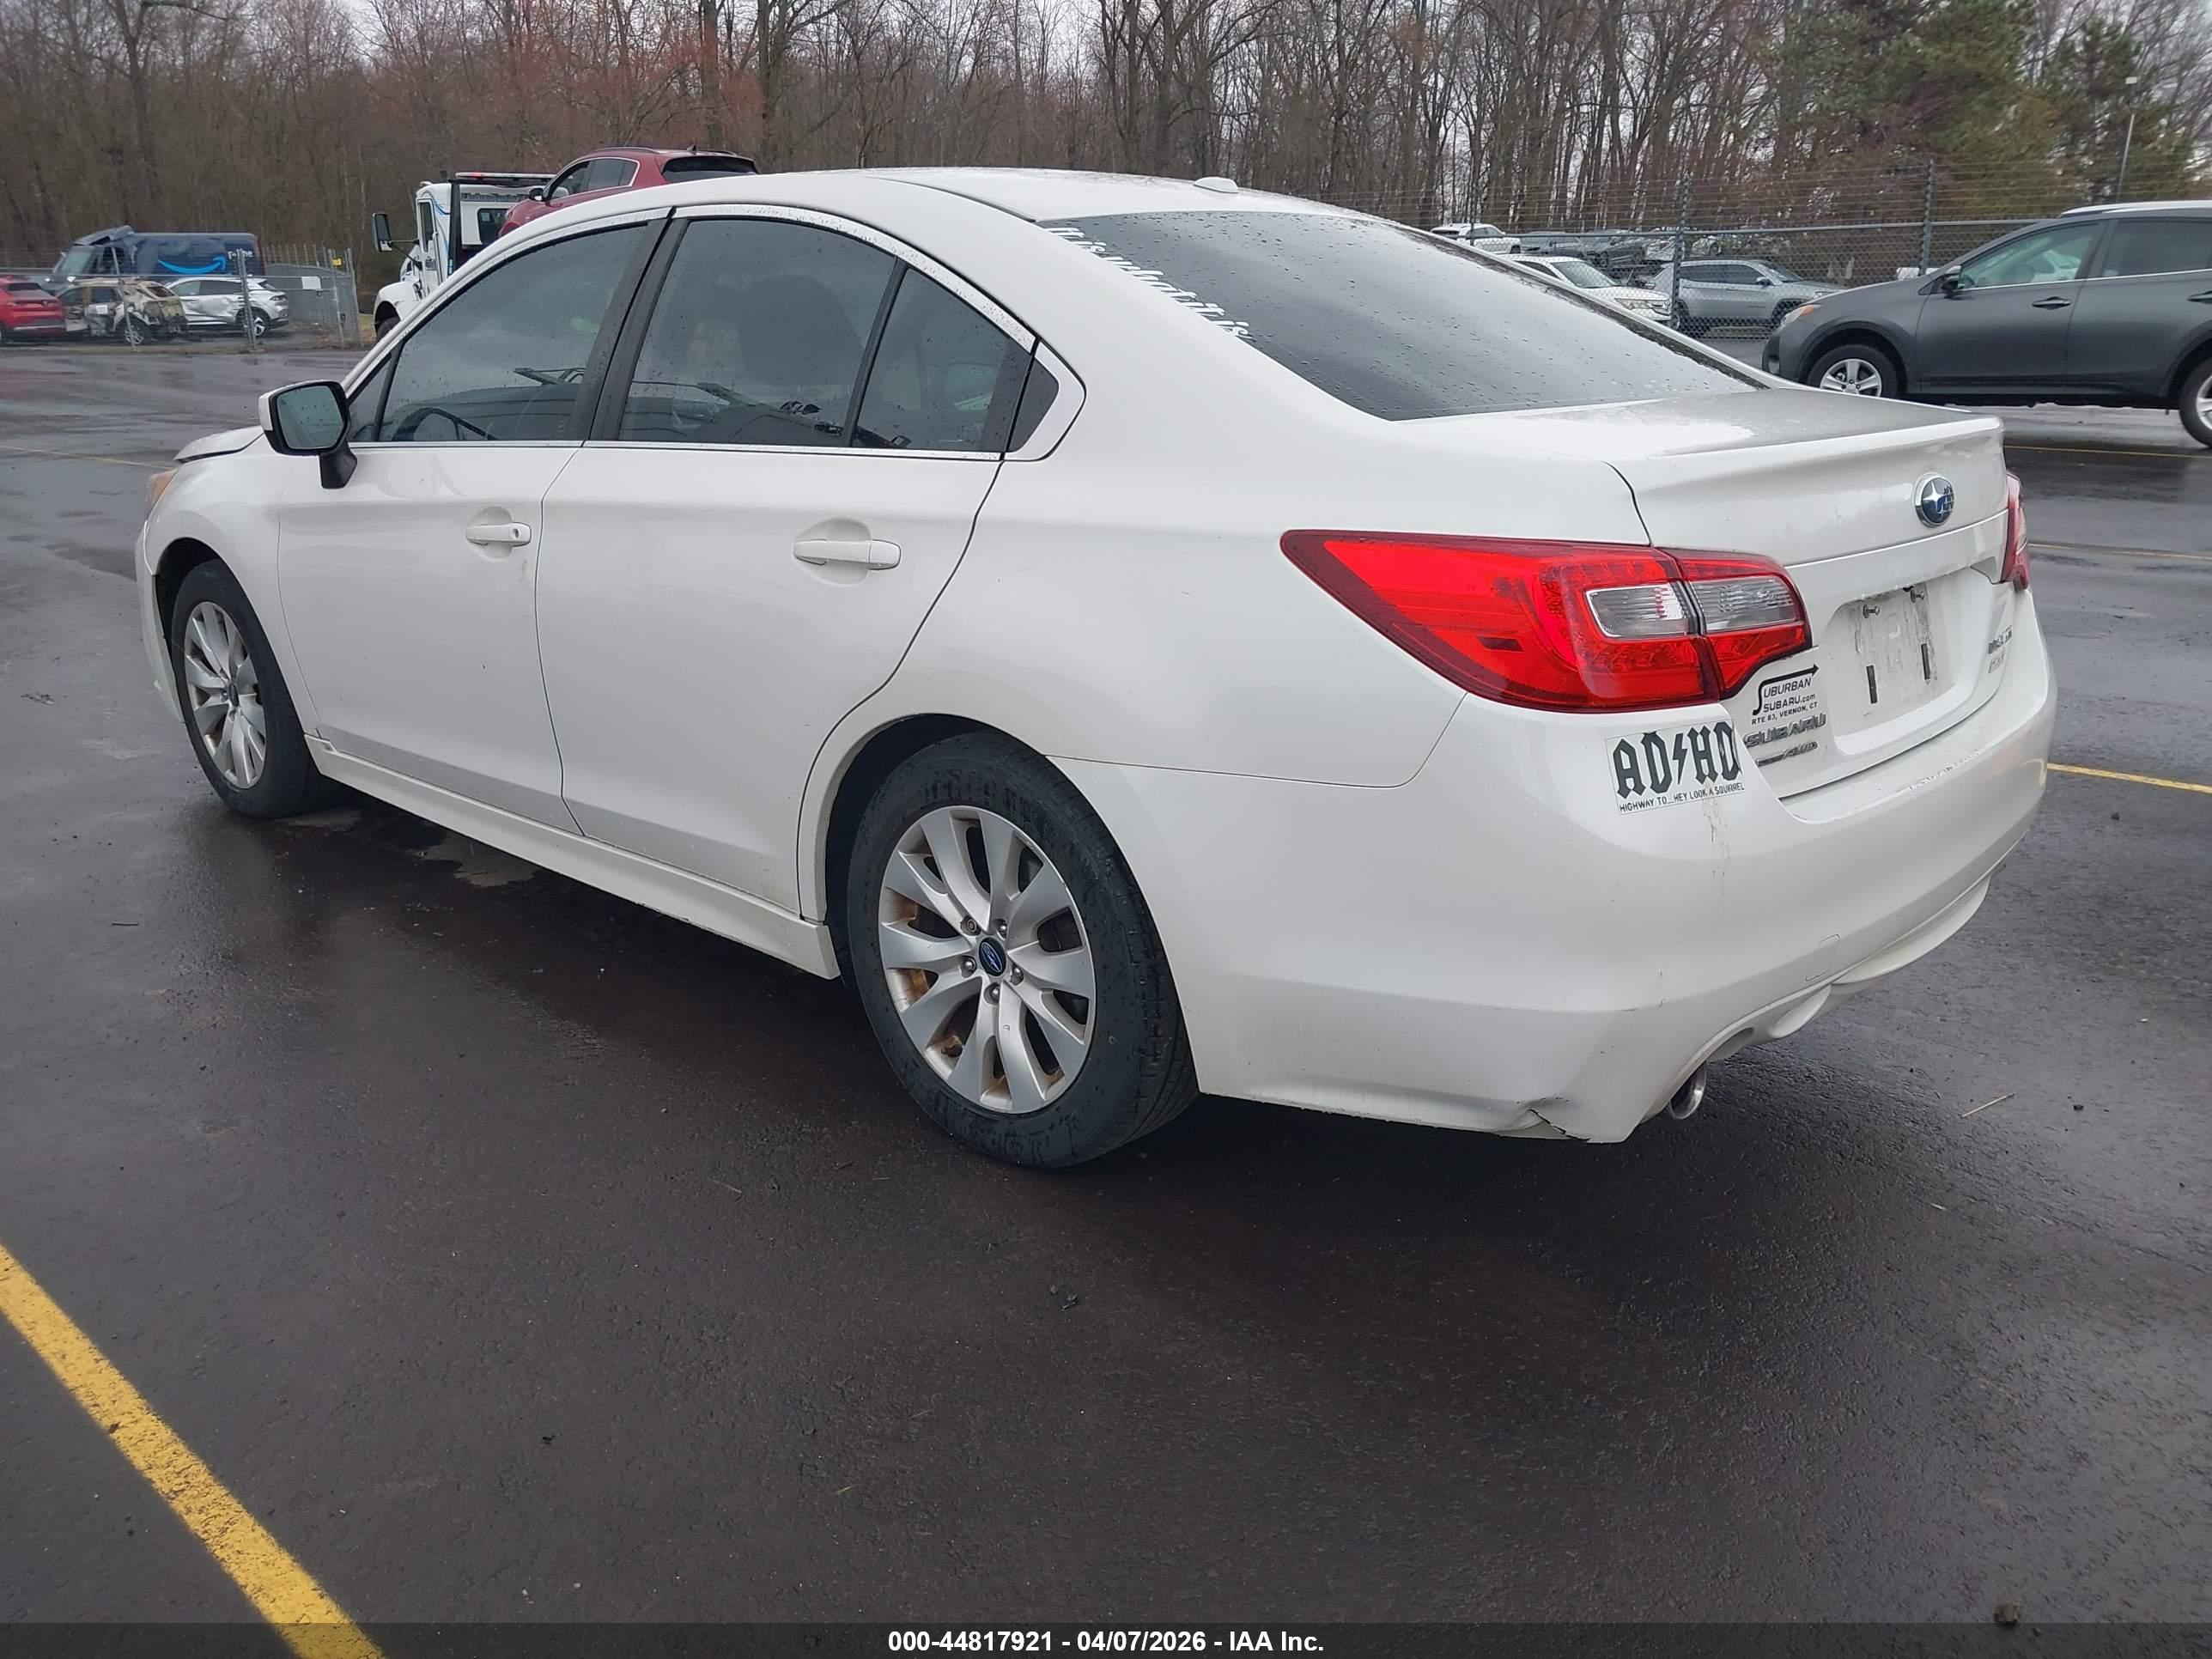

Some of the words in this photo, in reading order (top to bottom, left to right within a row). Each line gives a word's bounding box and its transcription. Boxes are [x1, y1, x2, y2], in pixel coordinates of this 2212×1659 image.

[1752, 716, 1766, 726] RTE
[1779, 705, 1808, 718] VERNON,
[1809, 701, 1819, 709] CT
[1763, 694, 1816, 713] SUBARU.com
[1742, 712, 1827, 749] SUBARU
[1620, 798, 1656, 813] HIGHWAY
[1689, 789, 1708, 799] LOOK
[1709, 787, 1715, 796] A
[1716, 782, 1745, 795] SQUIRREL
